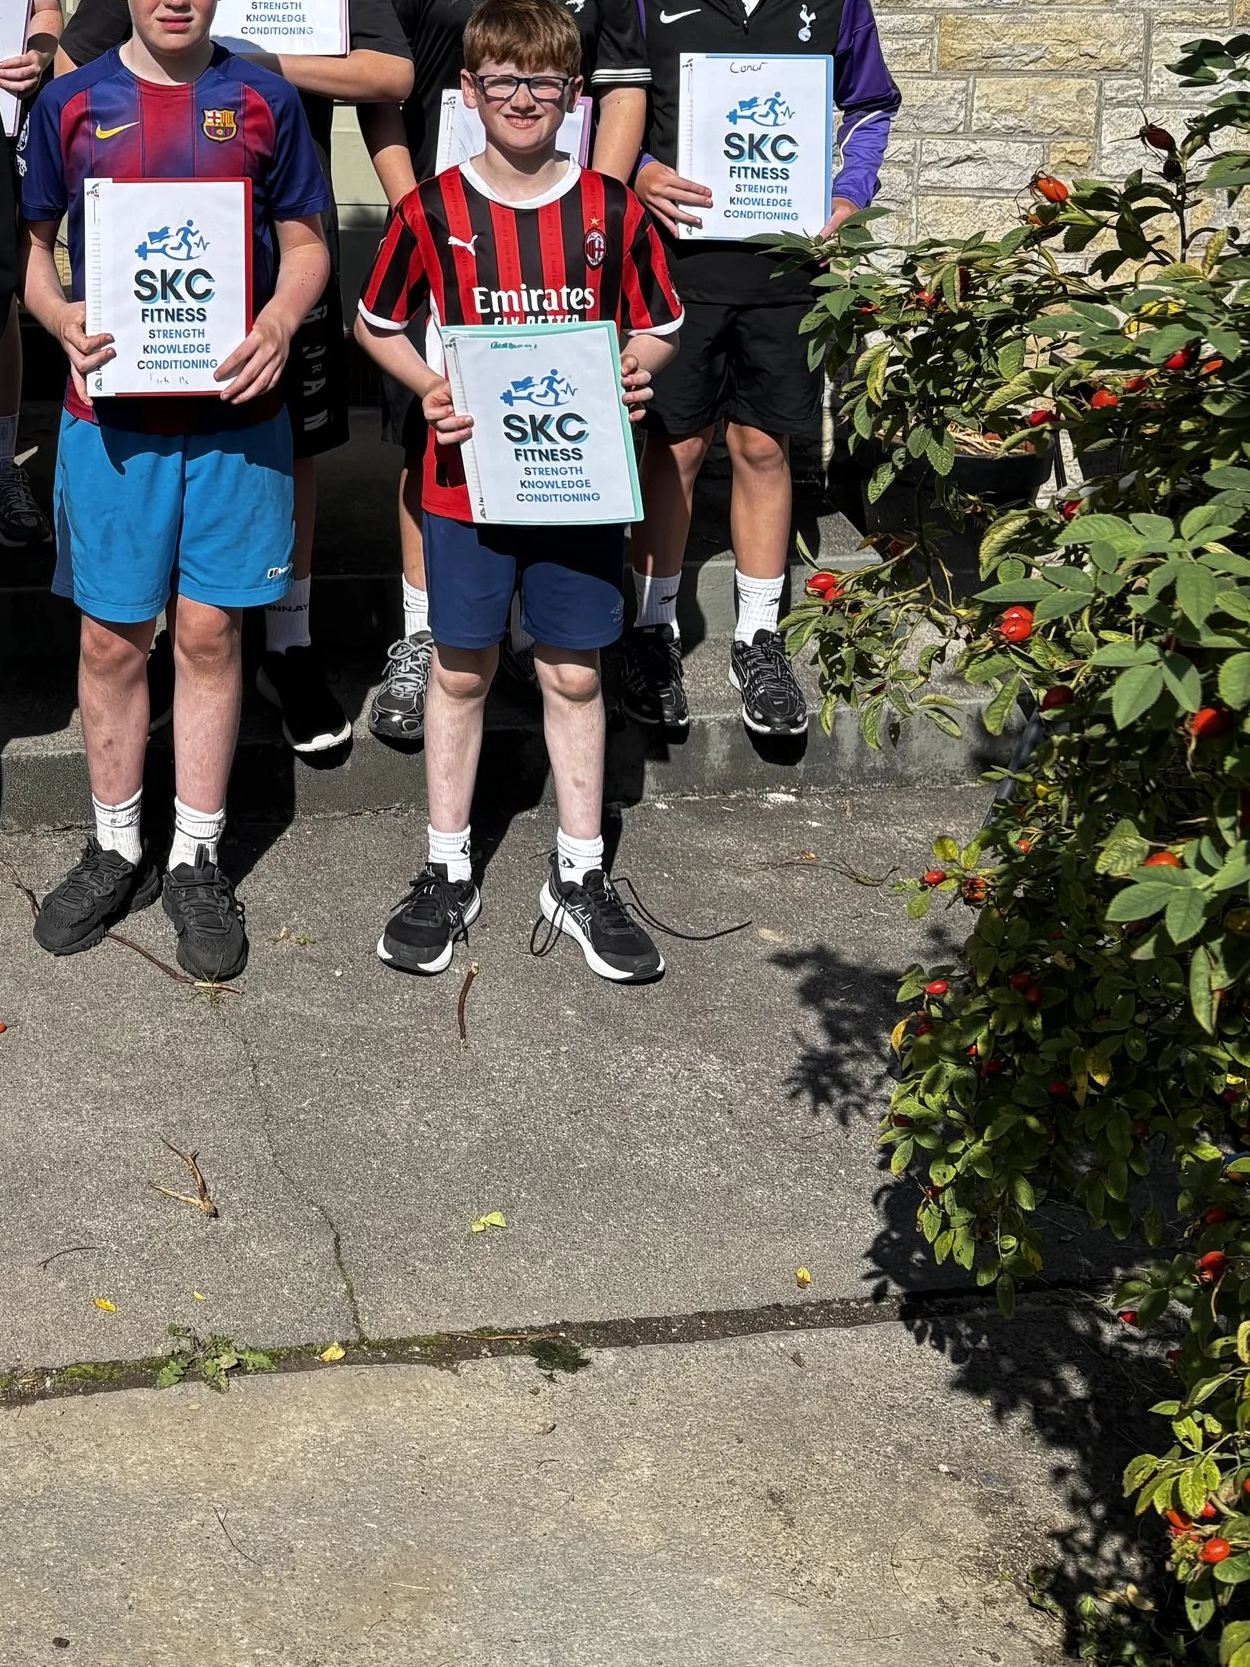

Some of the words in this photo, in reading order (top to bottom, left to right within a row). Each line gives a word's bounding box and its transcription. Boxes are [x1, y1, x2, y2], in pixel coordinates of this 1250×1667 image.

[251, 1, 302, 10] STRENGTH
[246, 14, 306, 22] KNOWLEDGE
[241, 26, 313, 35] CONDITIONING
[723, 132, 799, 164] SKC
[729, 166, 790, 180] FITNESS
[735, 184, 787, 194] STRENGTH
[729, 196, 792, 207] KNOWLEDGE
[723, 209, 799, 220] CONDITIONING
[134, 268, 216, 304] SKC
[472, 283, 595, 313] Emirates
[141, 307, 207, 323] FITNESS
[148, 328, 205, 339] STRENGTH
[142, 343, 211, 354] KNOWLEDGE
[137, 359, 218, 370] CONDITIONING
[503, 412, 590, 445] SKC
[514, 447, 583, 462] FITNESS
[524, 466, 583, 475] STRENGTH
[520, 479, 591, 489] KNOWLEDGE
[516, 492, 601, 502] CONDITIONING
